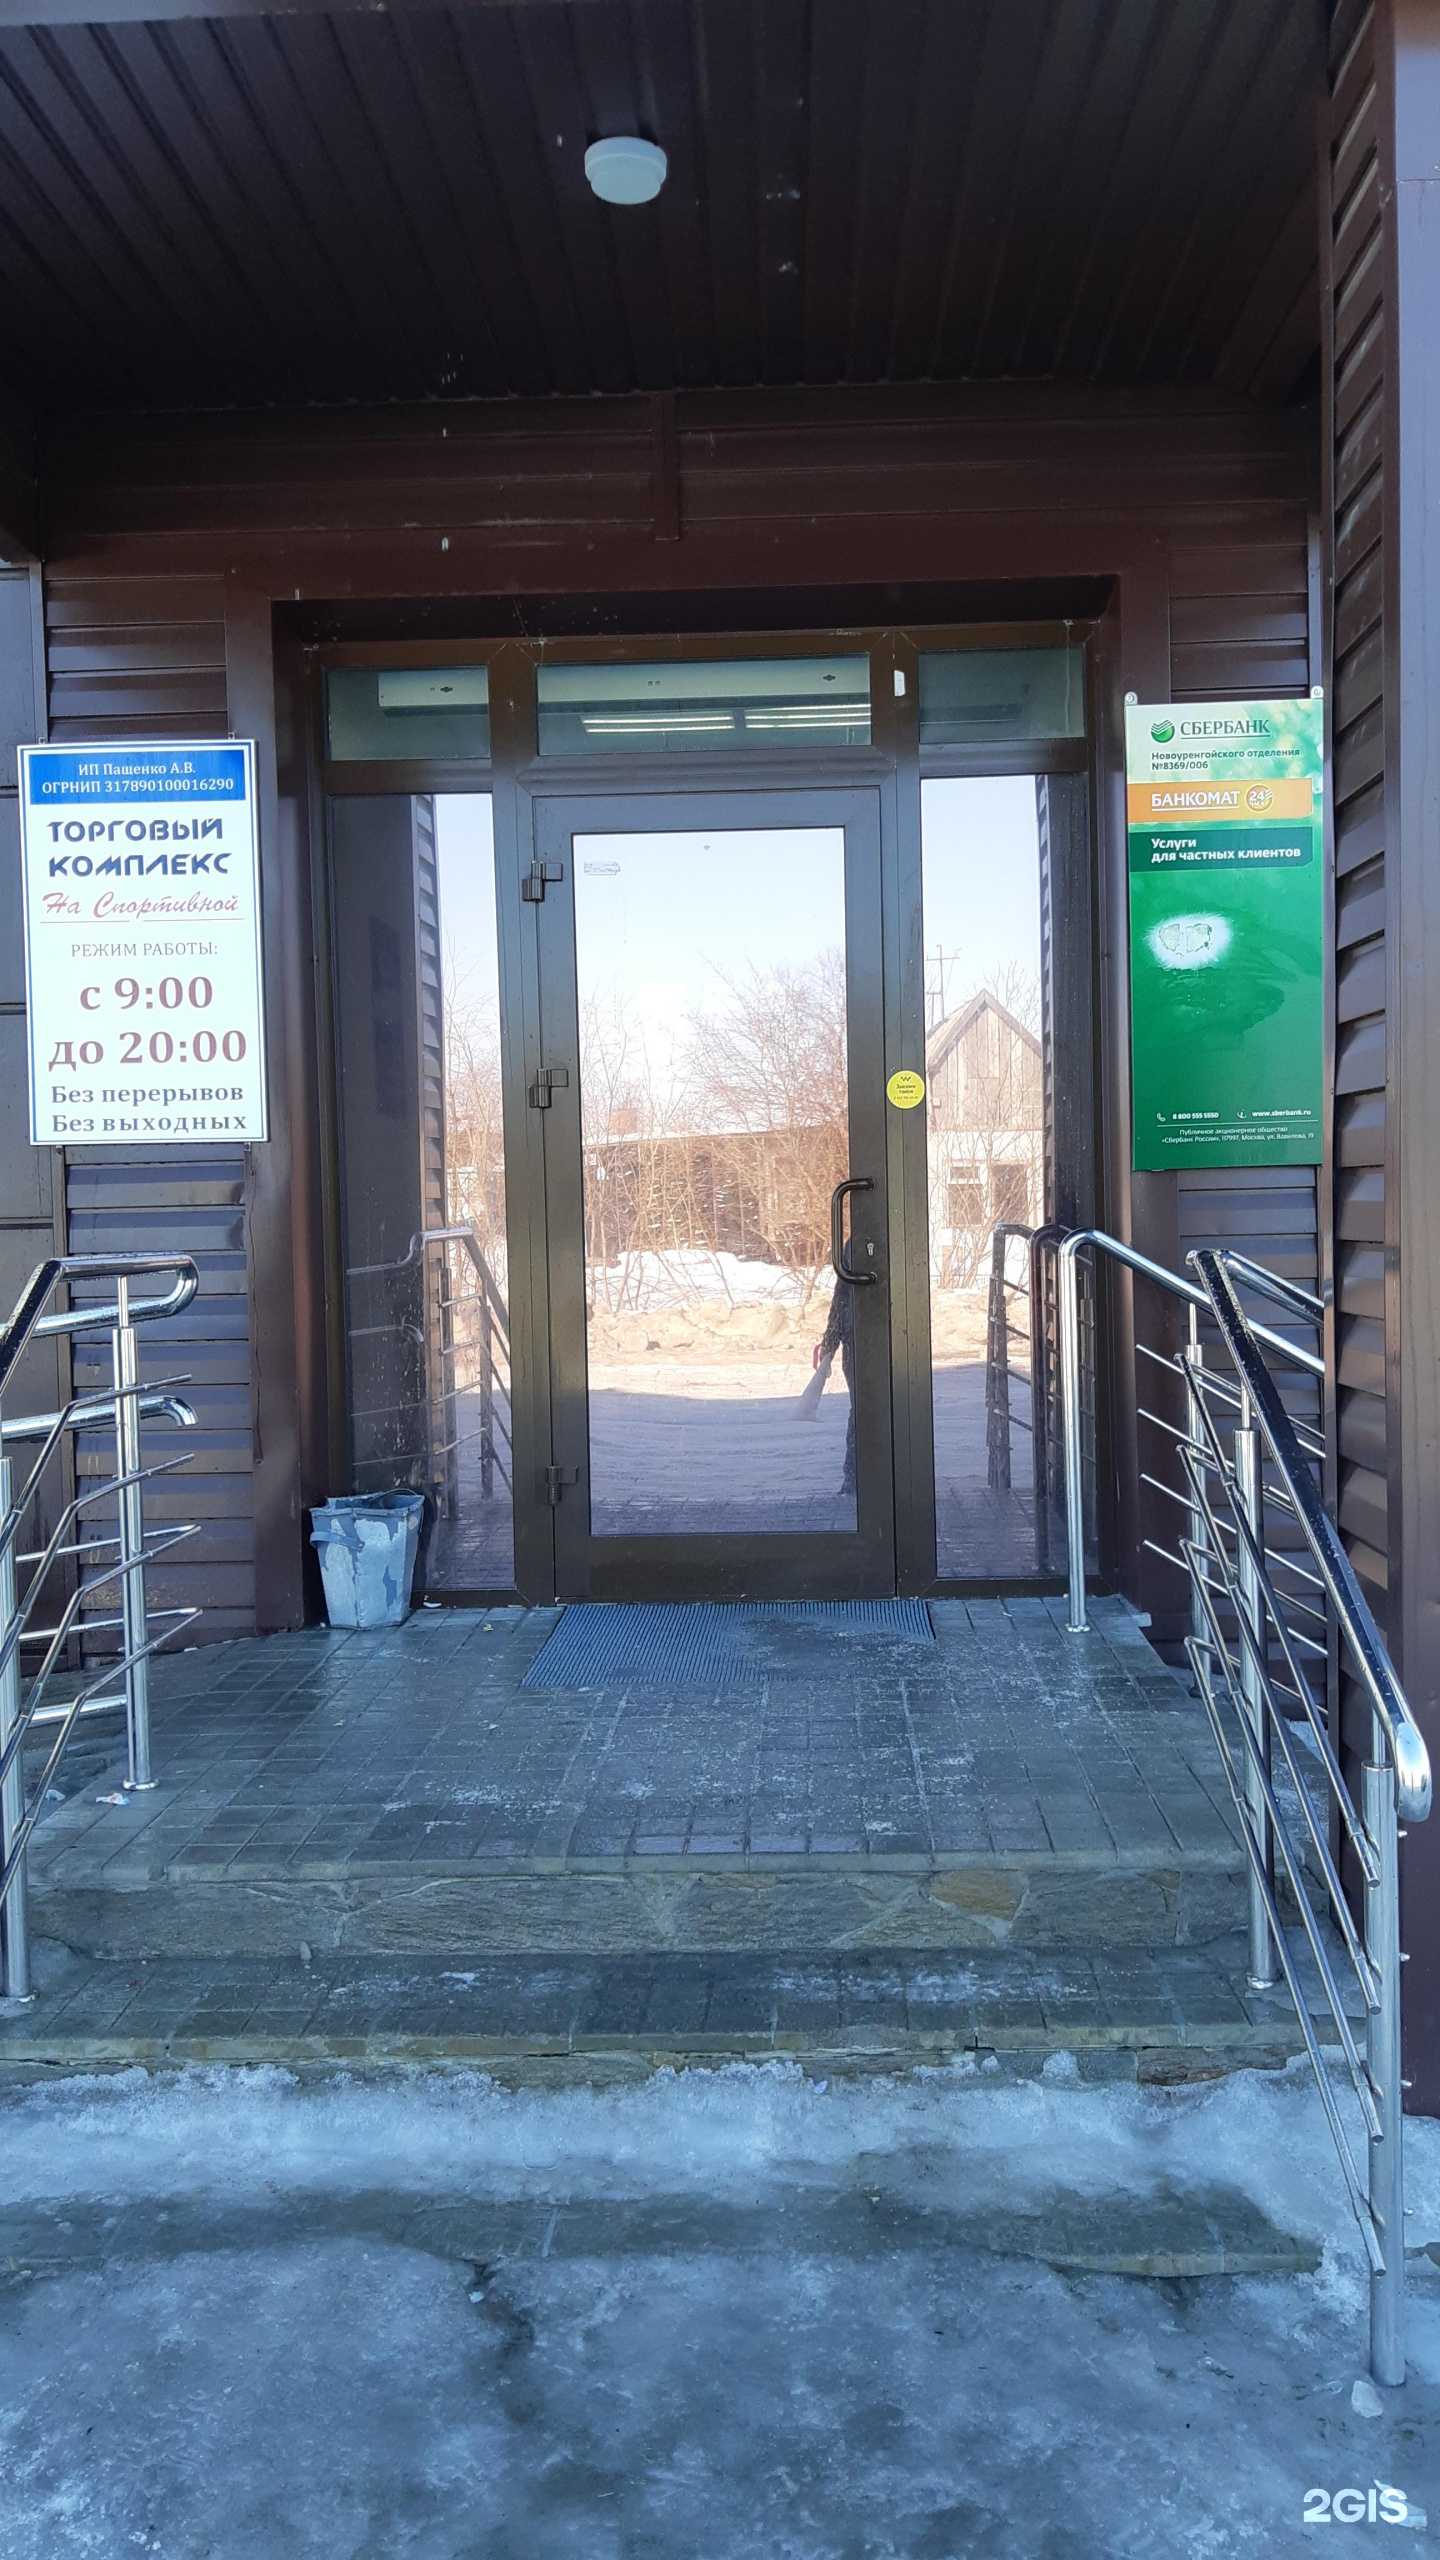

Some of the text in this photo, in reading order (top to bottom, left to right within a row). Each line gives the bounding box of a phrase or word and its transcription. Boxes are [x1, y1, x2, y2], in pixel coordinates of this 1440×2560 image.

[1180, 719, 1271, 736] СБЕРБАНК
[1151, 748, 1301, 762] Новоуренгойского отделения
[79, 762, 196, 777] ИП Пащенко А.В.
[42, 781, 101, 793] ОГРНИП
[1151, 790, 1241, 808] БАНКОМАТ
[47, 818, 223, 843] ТОРГОВЫЙ
[1151, 838, 1197, 851] Услуги
[1151, 847, 1301, 864] для частных клиентов
[49, 853, 232, 877] КОМПЛЕКС
[42, 891, 239, 919] На Спортивной
[71, 942, 219, 957] РЕЖИМ РАБОТЫ:
[80, 976, 213, 1010] с 9:00
[48, 1030, 247, 1072] до 20:00
[51, 1086, 244, 1106] Без перерывов
[52, 1115, 247, 1134] Без выходных
